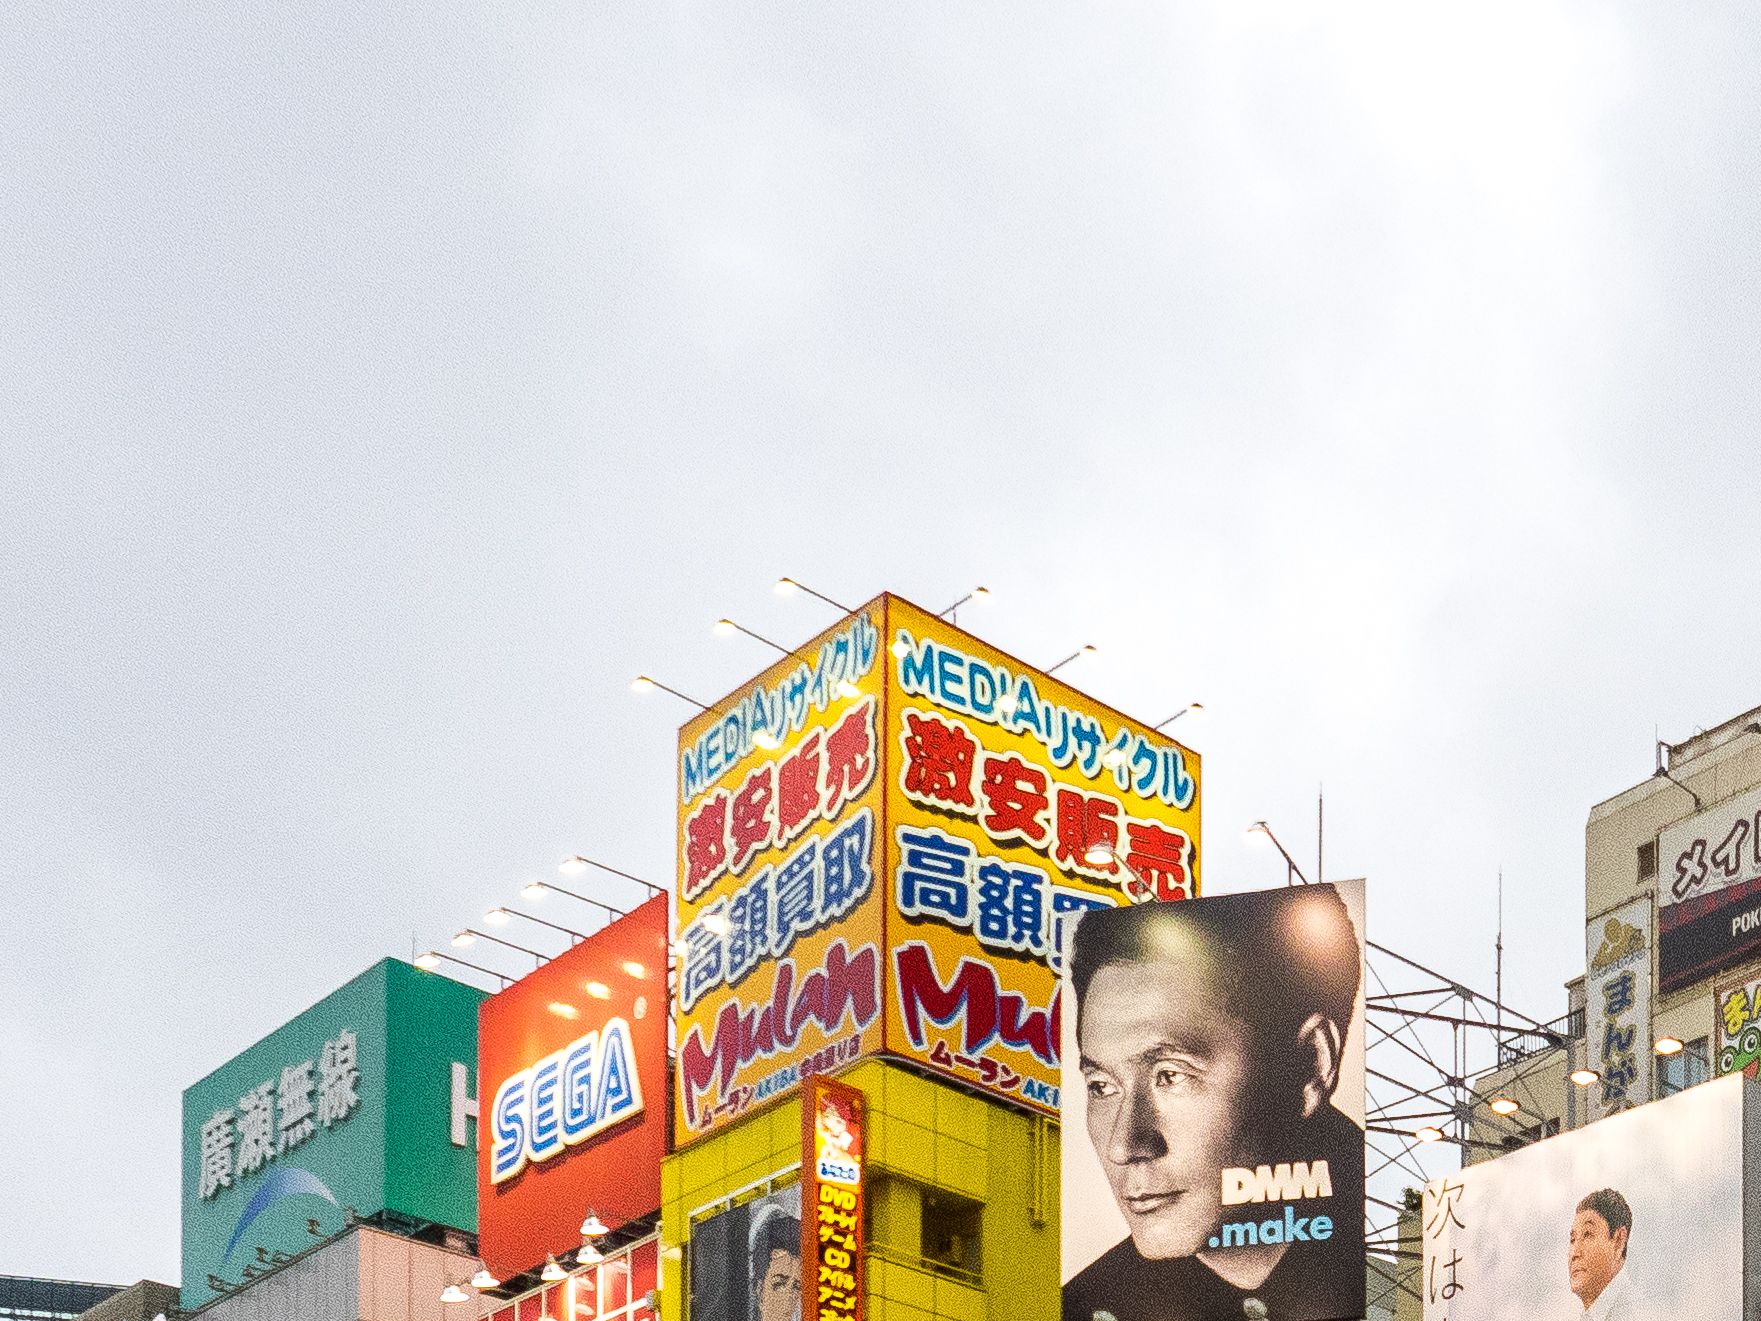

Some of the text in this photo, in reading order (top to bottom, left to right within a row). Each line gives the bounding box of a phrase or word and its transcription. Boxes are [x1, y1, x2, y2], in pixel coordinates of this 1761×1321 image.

[902, 632, 1193, 808] MEDIAリサイクル
[1604, 973, 1637, 1115] まんが
[491, 1016, 645, 1186] SEGA
[1022, 1078, 1061, 1108] AKI
[1208, 1206, 1334, 1249] .make
[1221, 1160, 1334, 1206] DMM
